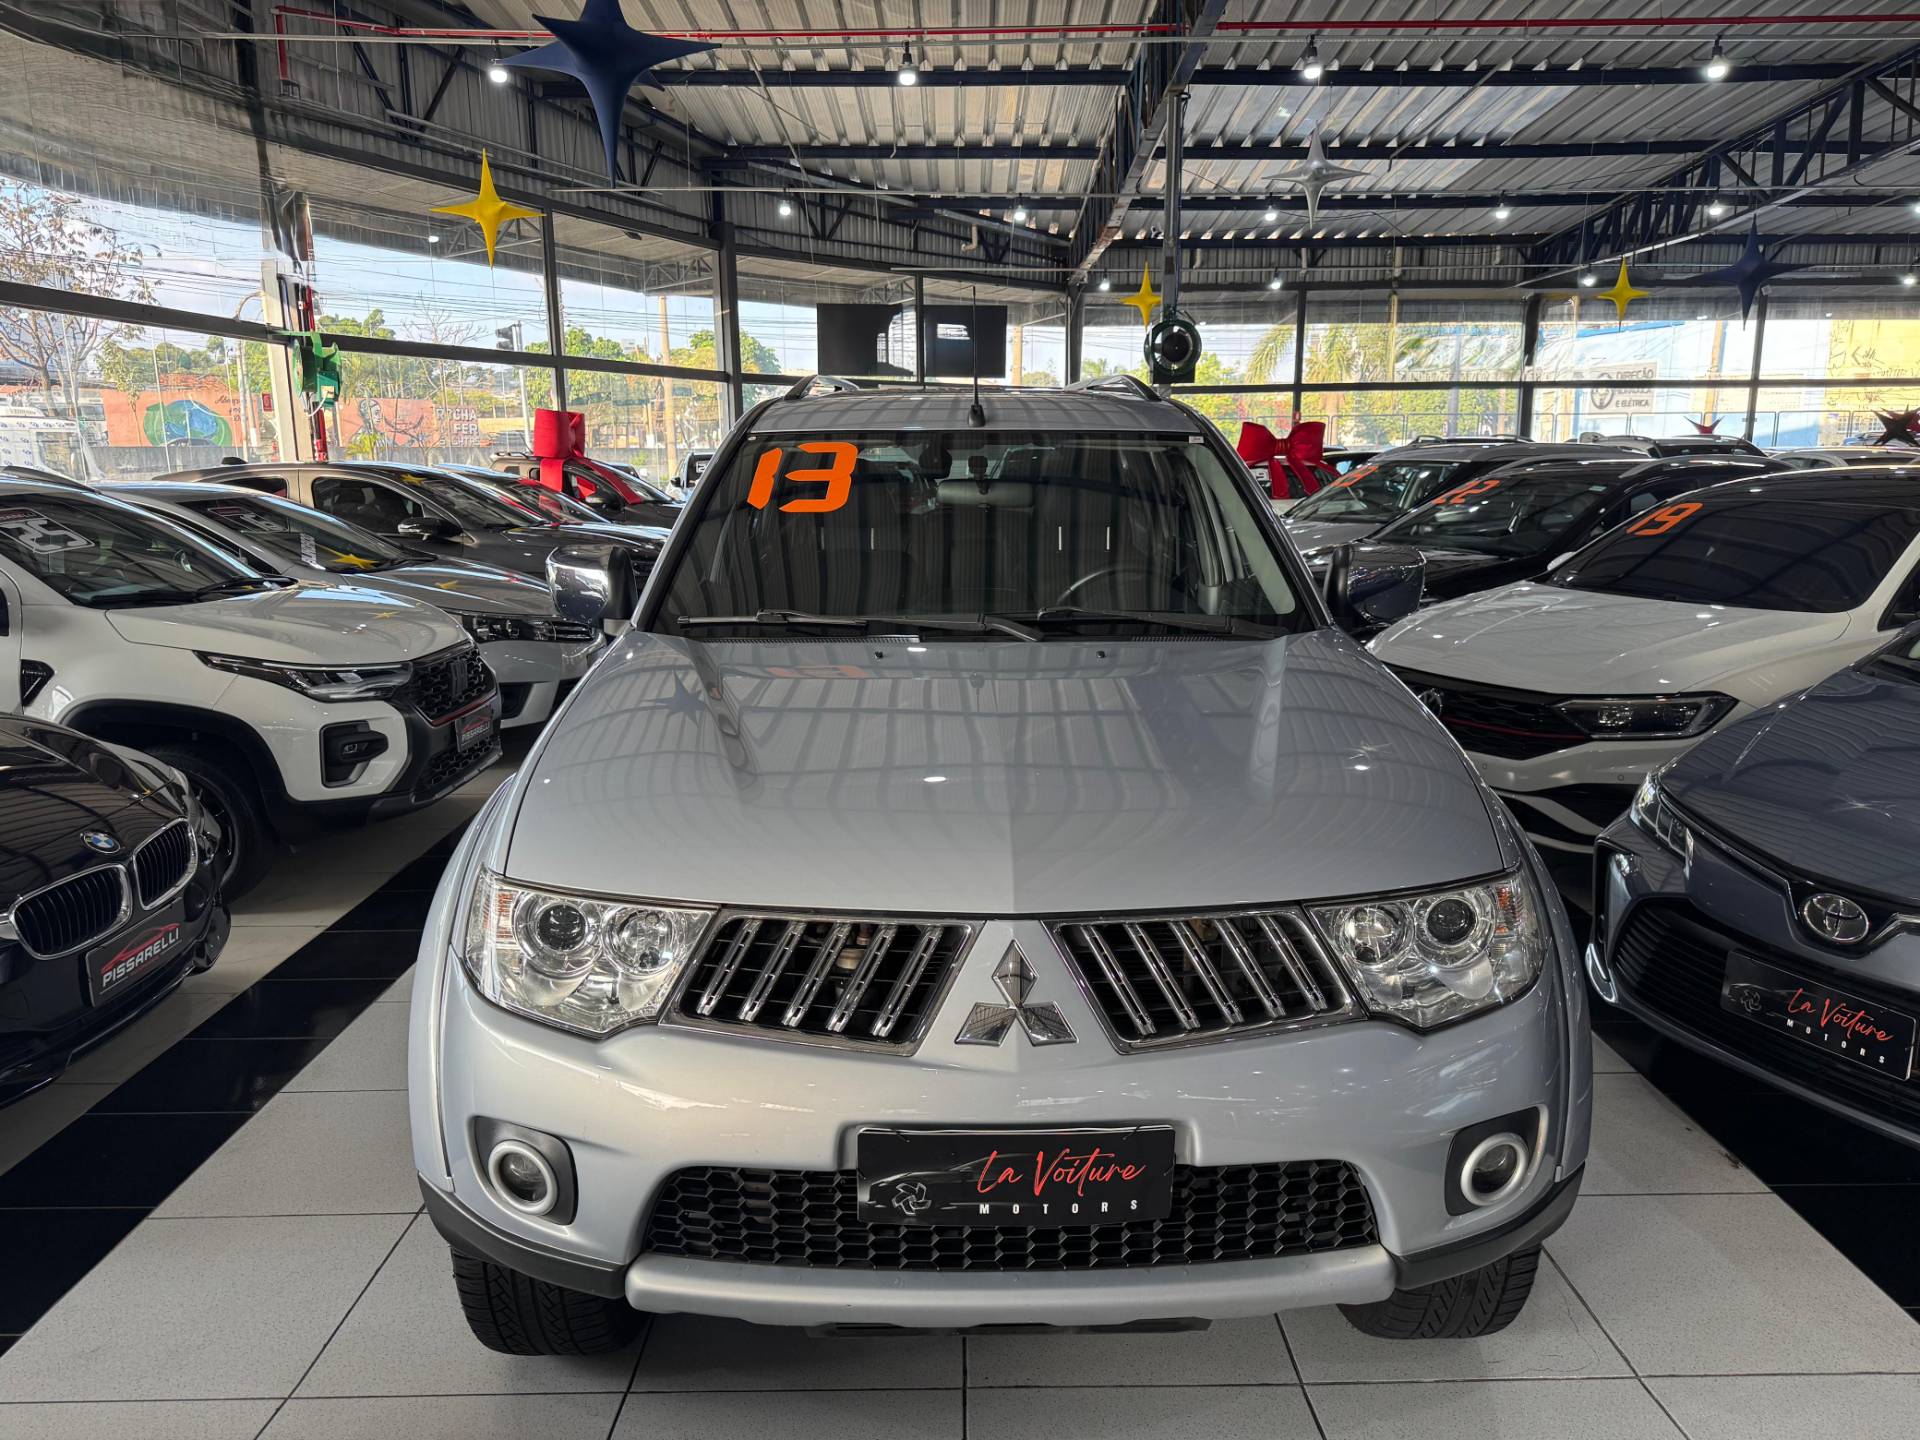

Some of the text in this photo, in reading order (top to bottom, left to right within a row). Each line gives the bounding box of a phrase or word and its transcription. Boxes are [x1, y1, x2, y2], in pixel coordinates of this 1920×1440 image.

[747, 441, 858, 513] 13
[1432, 479, 1500, 505] 22
[0, 520, 88, 551] 25
[1626, 503, 1704, 535] 19
[102, 927, 179, 988] PISSARELLI
[1787, 988, 1895, 1041] La Voiture
[1786, 1018, 1885, 1064] MOTORS
[977, 1148, 1146, 1197] La Voiture
[979, 1200, 1137, 1215] MOTORS
